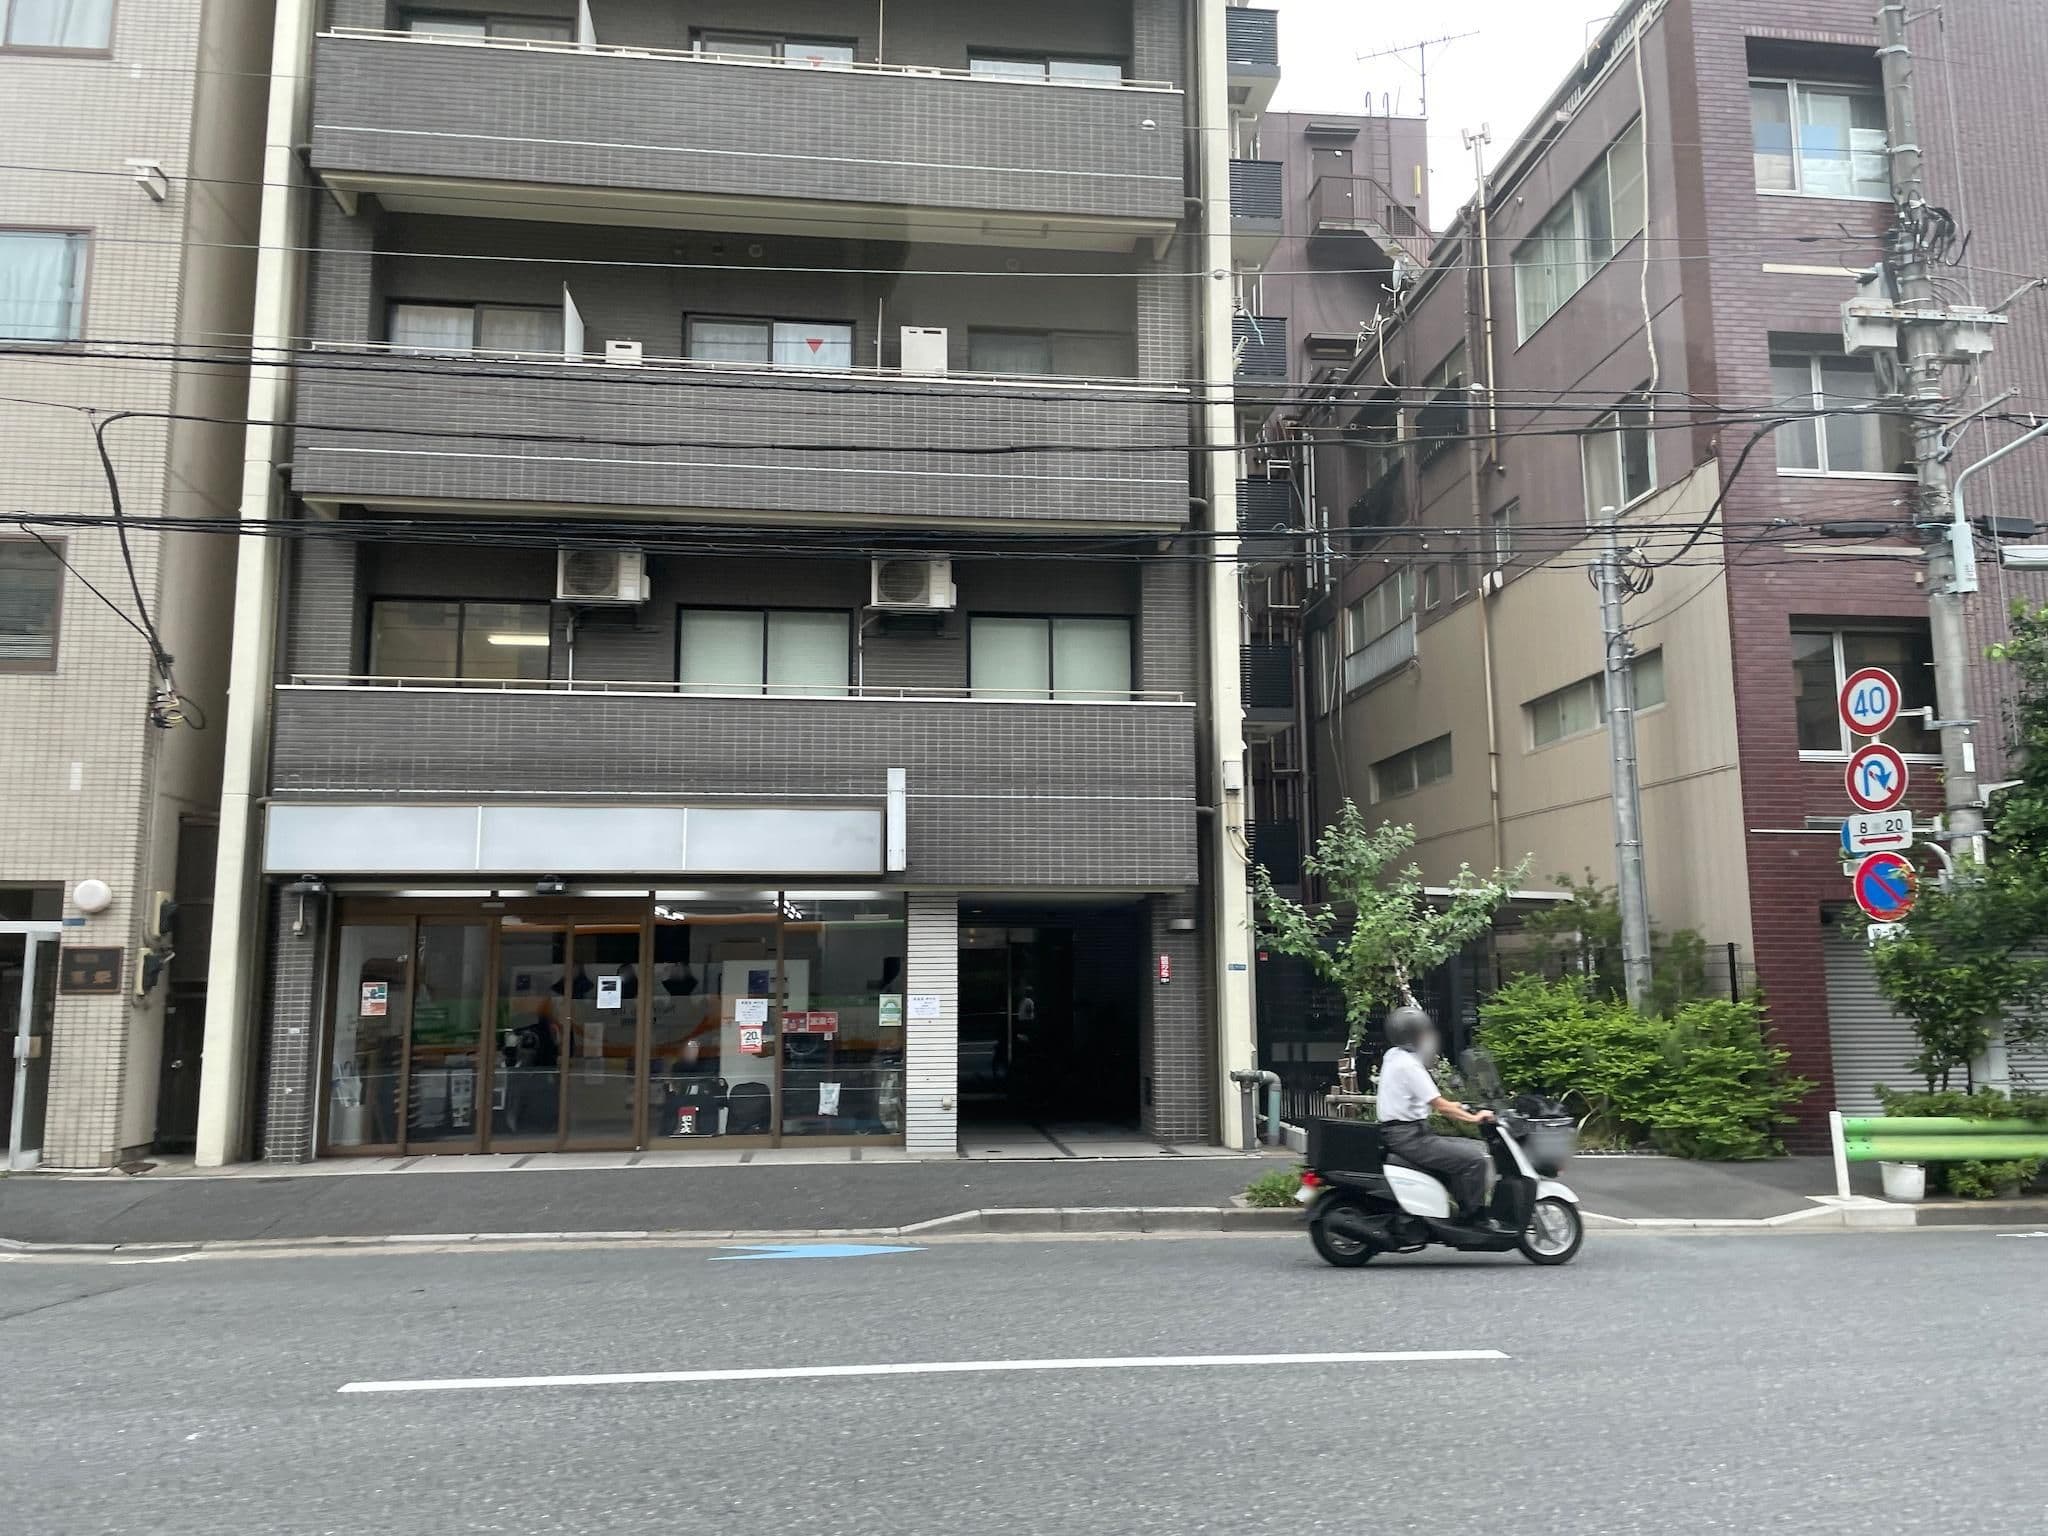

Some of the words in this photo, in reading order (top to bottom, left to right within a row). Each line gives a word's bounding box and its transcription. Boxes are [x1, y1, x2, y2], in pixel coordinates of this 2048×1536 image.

[1854, 686, 1885, 717] 40
[1860, 822, 1868, 834] 8
[1885, 818, 1904, 832] 20
